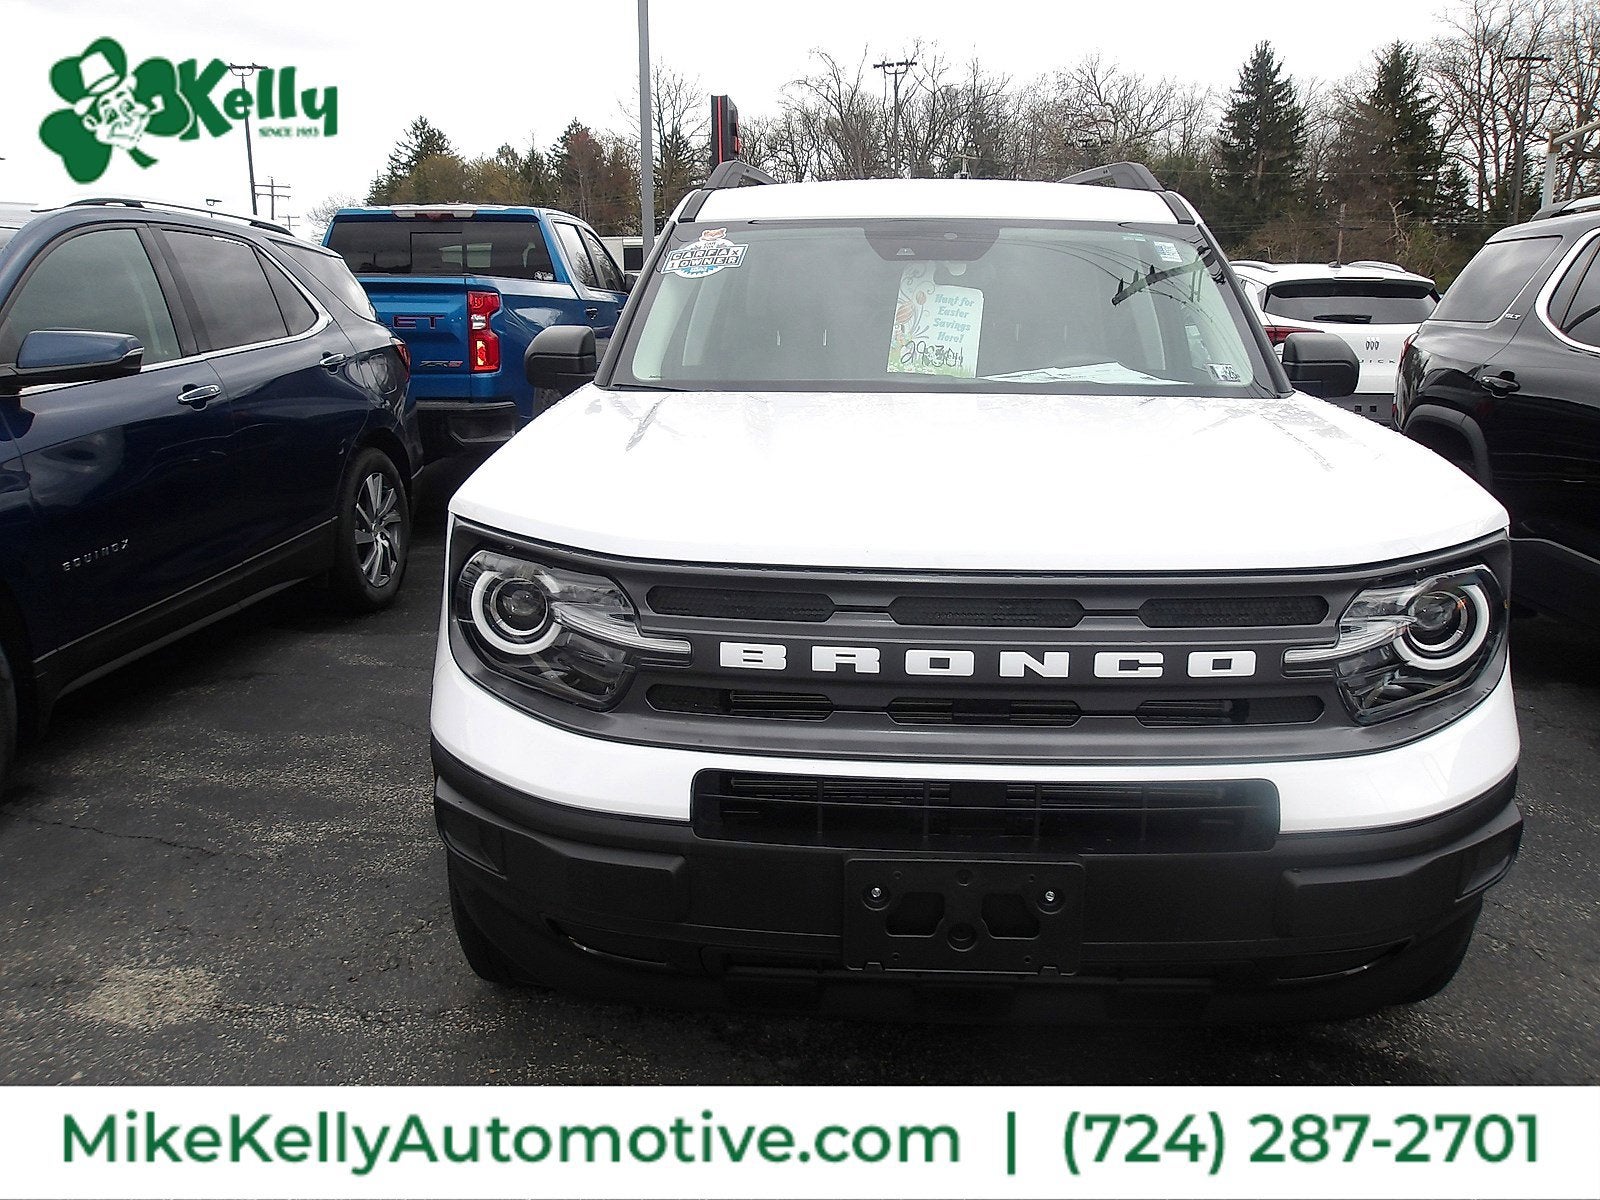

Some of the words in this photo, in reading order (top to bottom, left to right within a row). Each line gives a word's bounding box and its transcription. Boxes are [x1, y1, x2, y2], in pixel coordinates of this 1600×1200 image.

[671, 248, 740, 261] CARFAX
[680, 255, 738, 268] OWNER
[935, 294, 958, 306] Hunt
[957, 297, 975, 307] for
[938, 306, 970, 319] Easter
[933, 318, 972, 332] Savings
[62, 538, 129, 571] EQUINOX
[719, 641, 1257, 679] BRONCO
